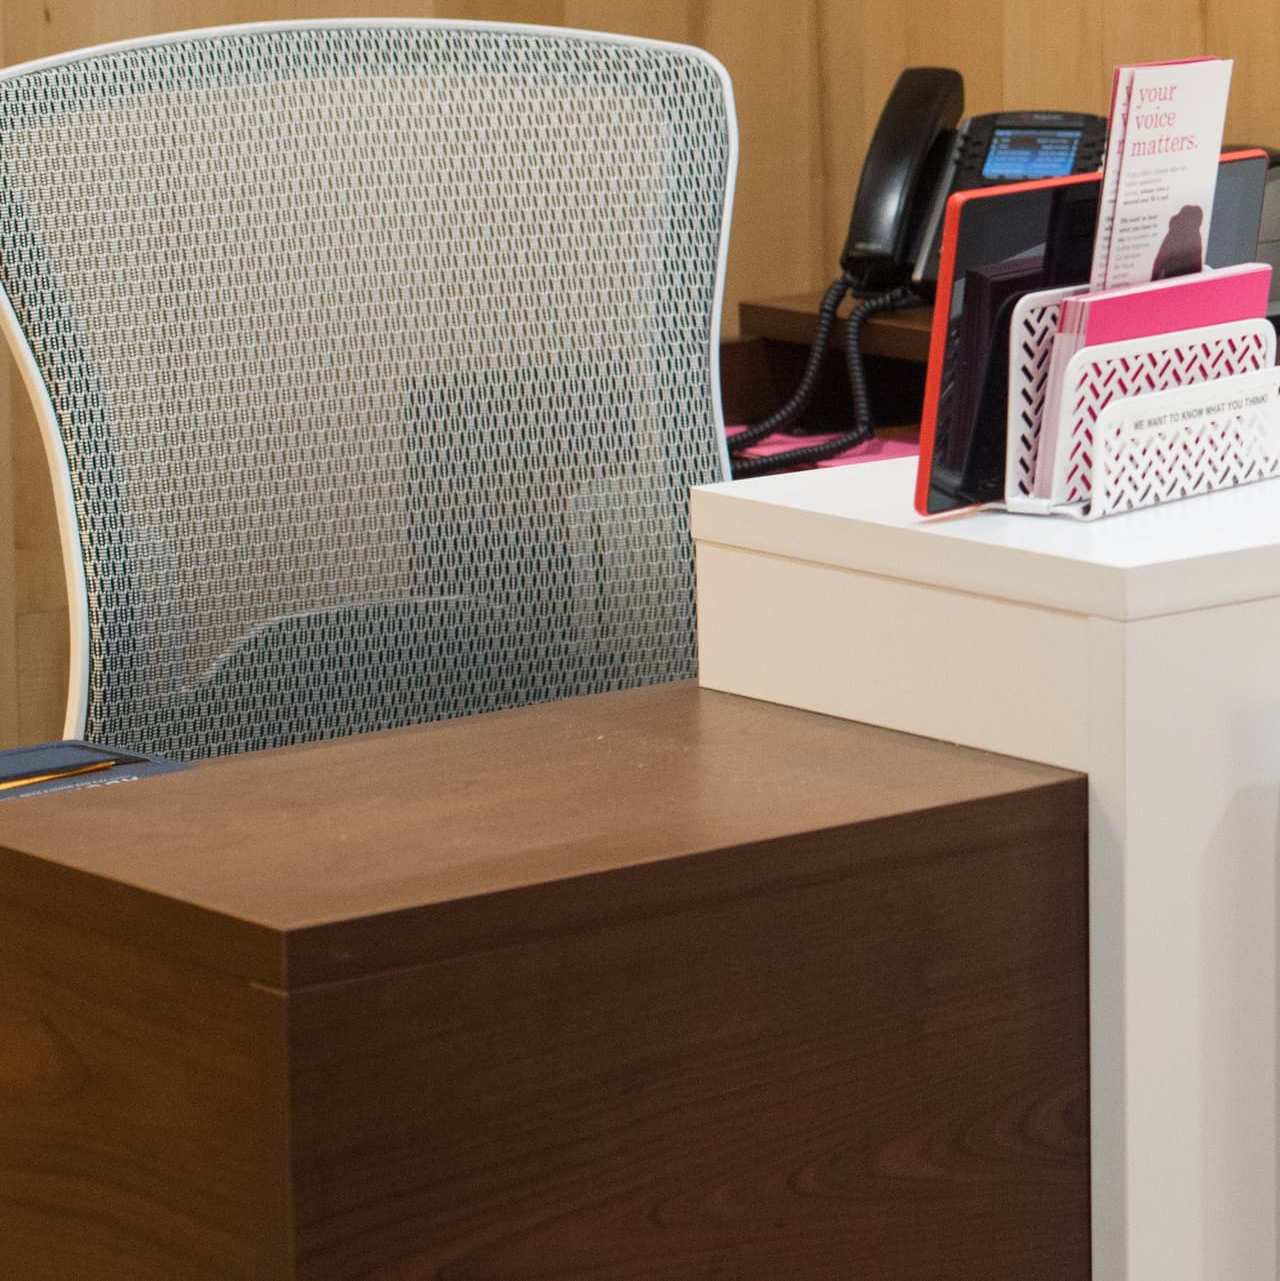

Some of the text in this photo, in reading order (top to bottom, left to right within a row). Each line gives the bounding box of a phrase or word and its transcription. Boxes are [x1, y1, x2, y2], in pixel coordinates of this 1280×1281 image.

[1136, 85, 1177, 109] your
[1135, 106, 1177, 130] voice
[1131, 134, 1199, 157] matters.
[1134, 421, 1144, 430] WE
[1147, 415, 1167, 427] WANT
[1170, 413, 1179, 423] TO
[1181, 408, 1204, 420] KNOW
[1206, 403, 1225, 415] WHAT
[1228, 399, 1243, 411] YOU
